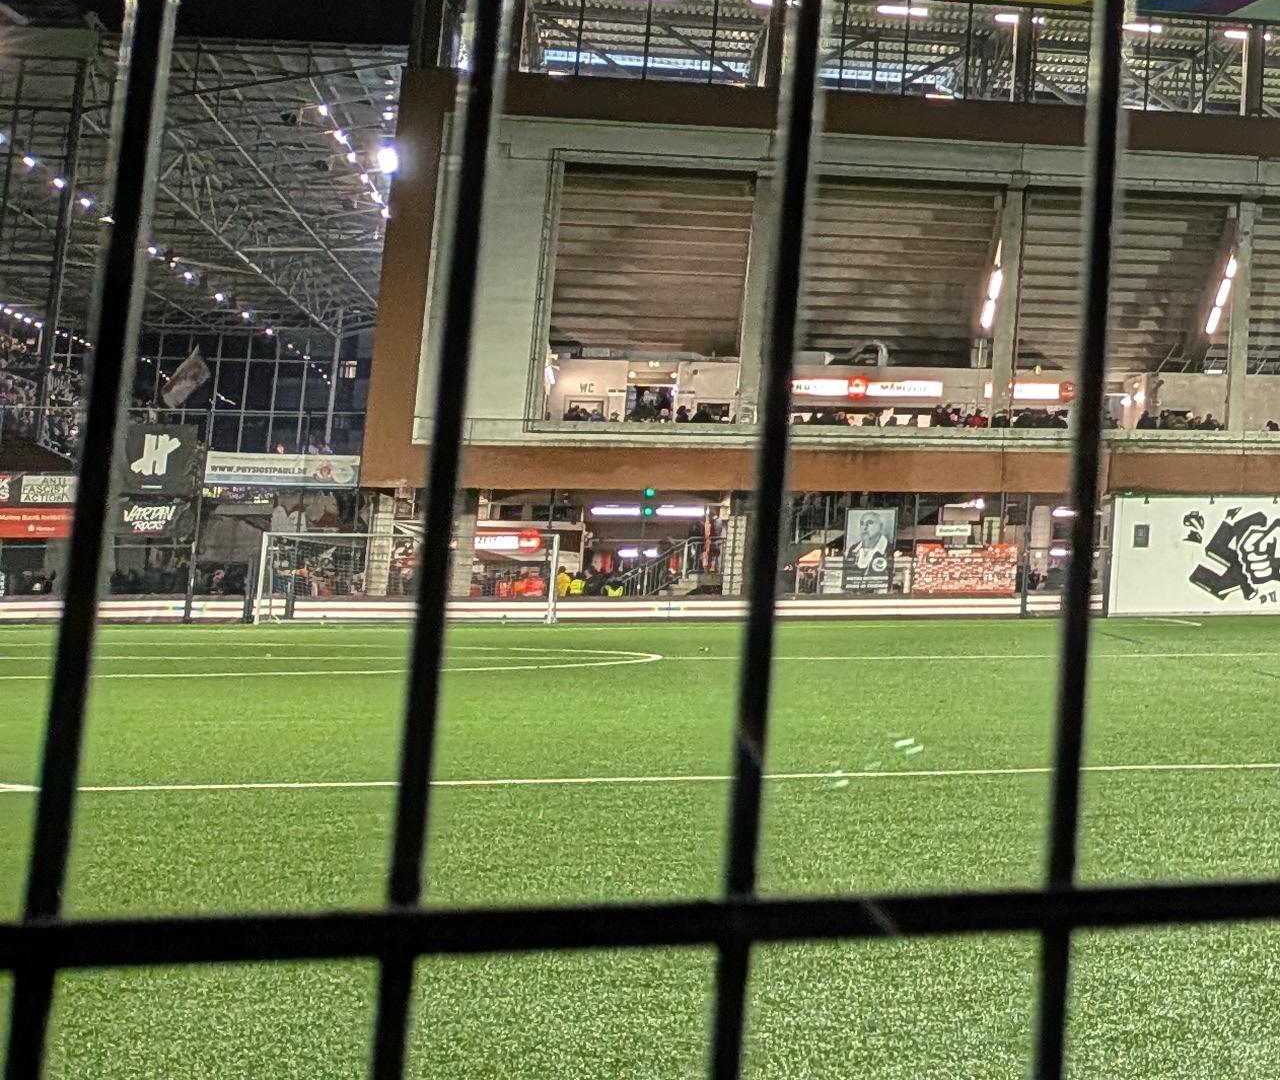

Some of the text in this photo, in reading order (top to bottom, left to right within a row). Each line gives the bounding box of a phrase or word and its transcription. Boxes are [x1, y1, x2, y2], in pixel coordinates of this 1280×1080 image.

[579, 383, 594, 393] WC
[41, 477, 67, 486] ANTI
[23, 485, 69, 495] FASCIST
[24, 494, 70, 502] ACTION
